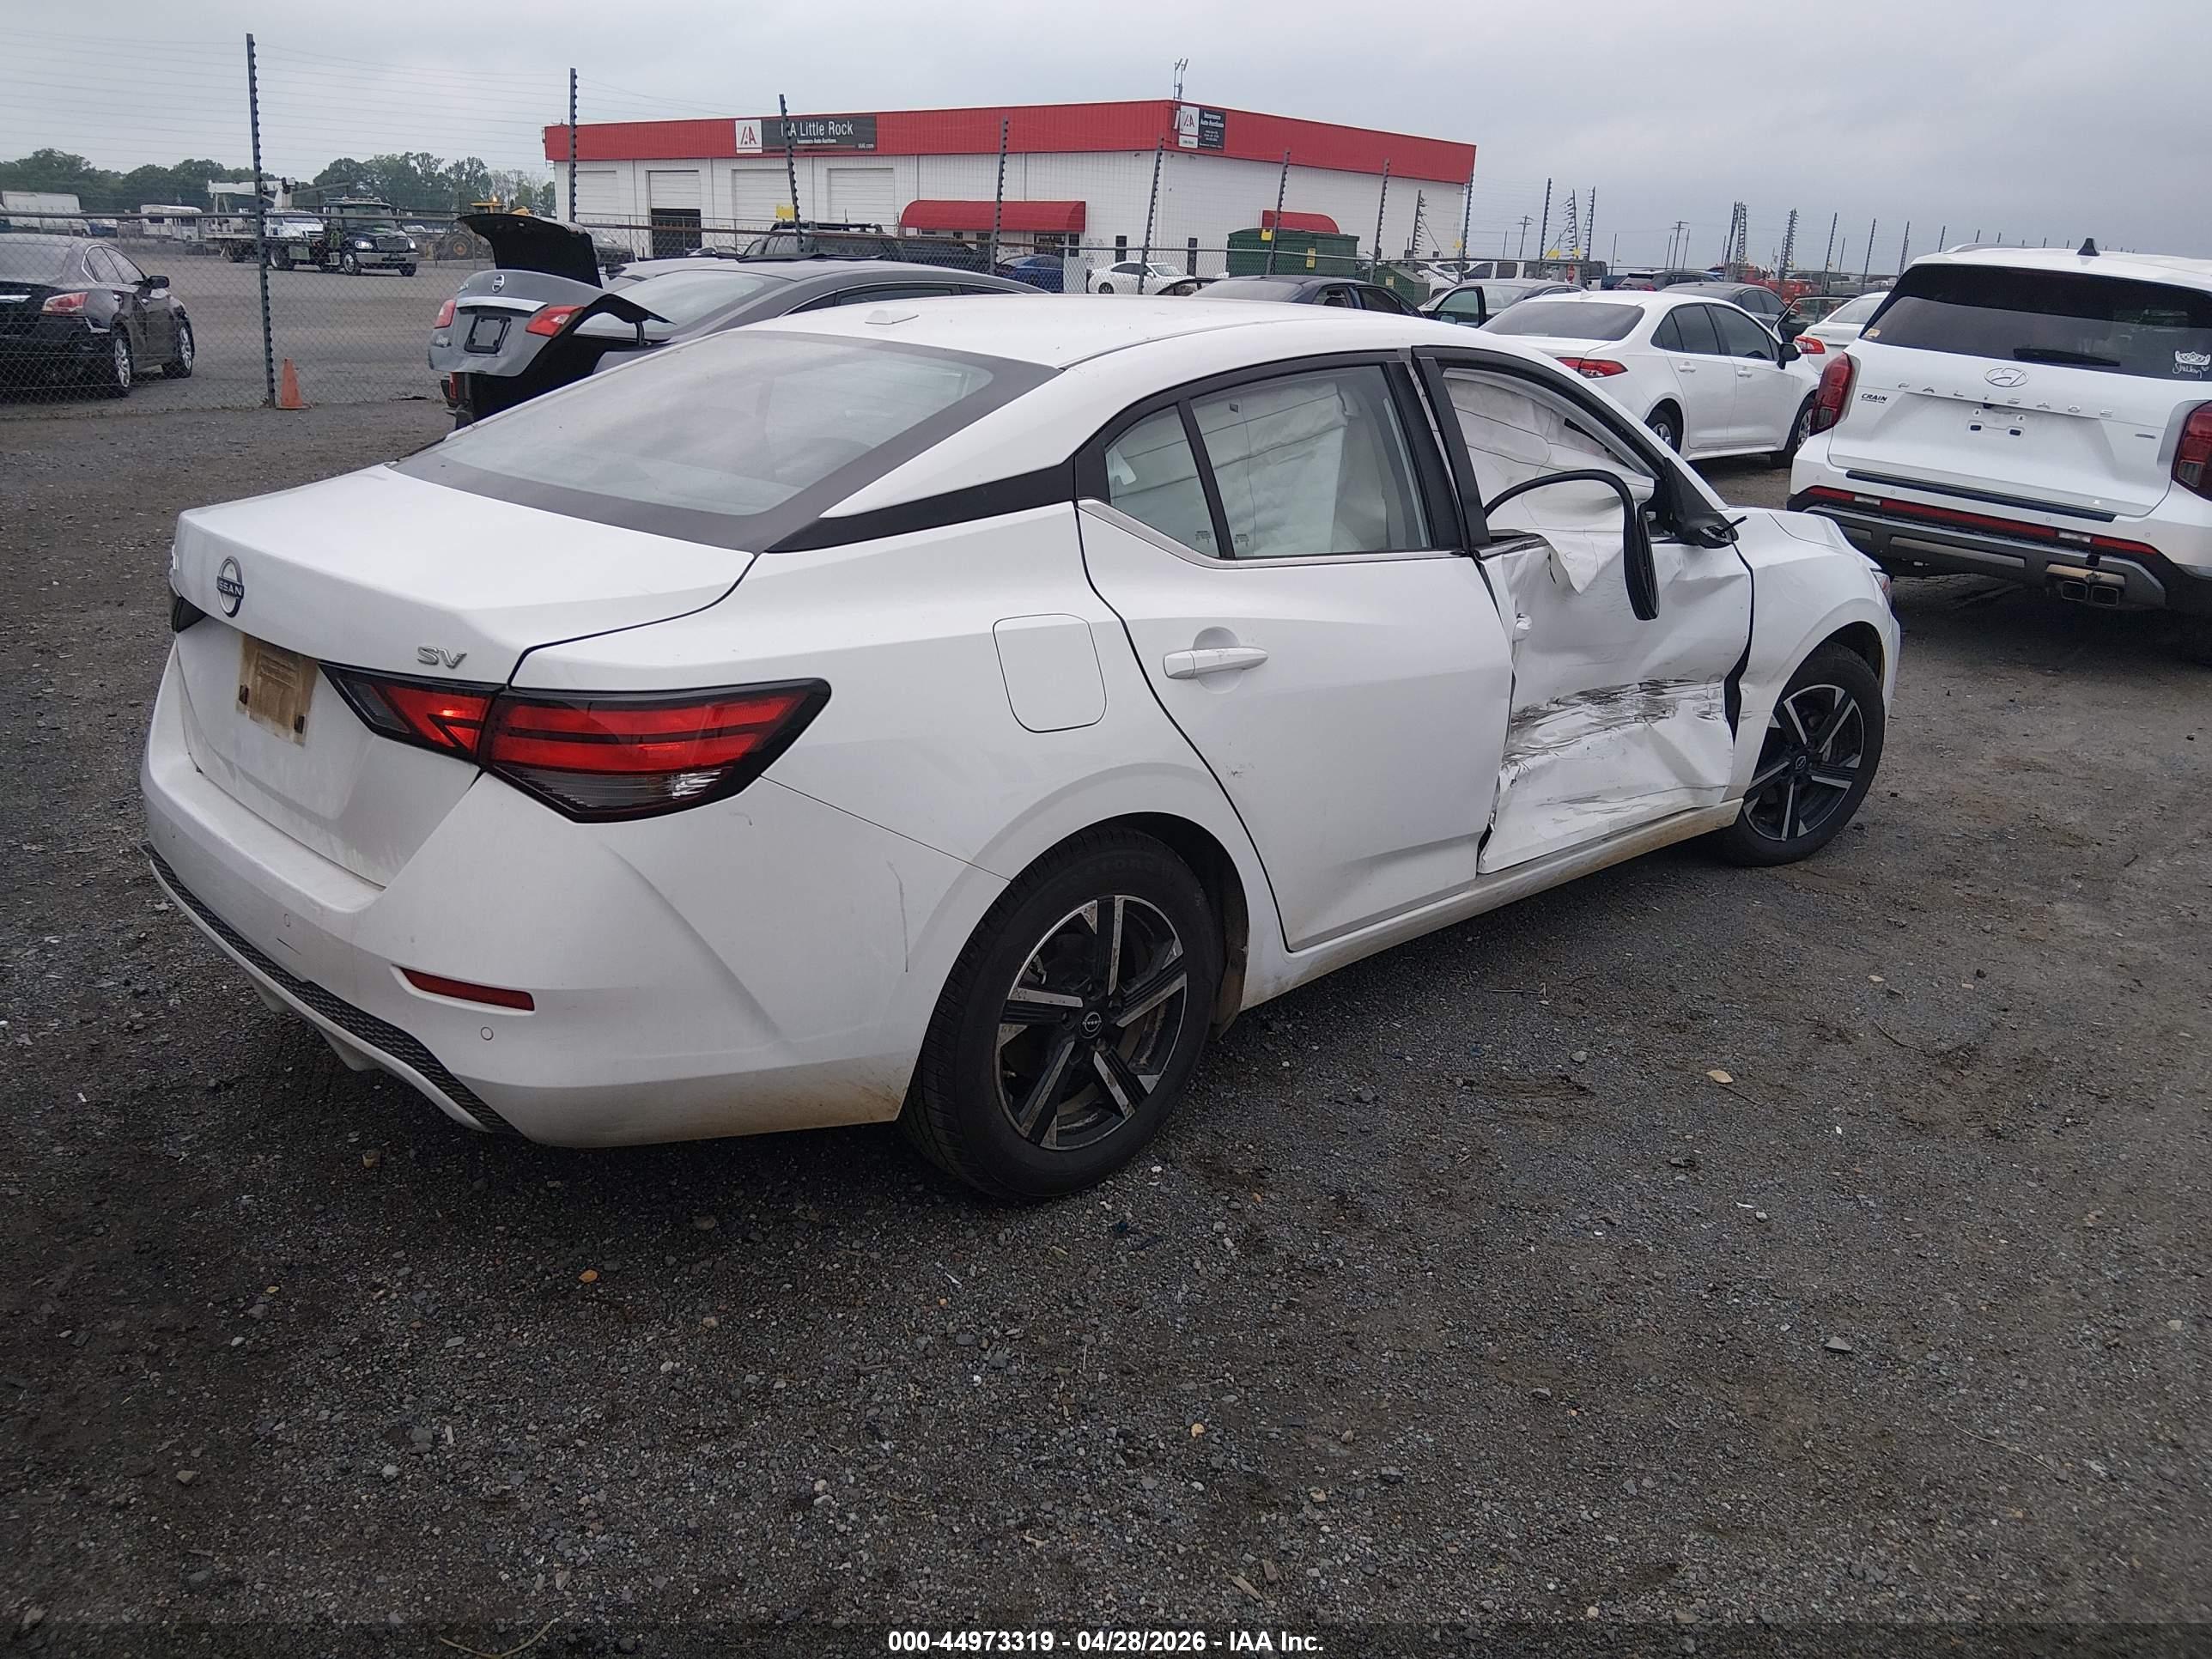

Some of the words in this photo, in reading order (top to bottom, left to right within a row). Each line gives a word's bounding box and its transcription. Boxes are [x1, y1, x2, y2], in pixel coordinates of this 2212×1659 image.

[781, 122, 797, 137] IA
[799, 120, 825, 137] Little
[828, 120, 854, 136] Rock
[1861, 393, 1888, 402] CRAIN
[1897, 382, 2113, 417] PALISADE
[417, 646, 468, 669] SV
